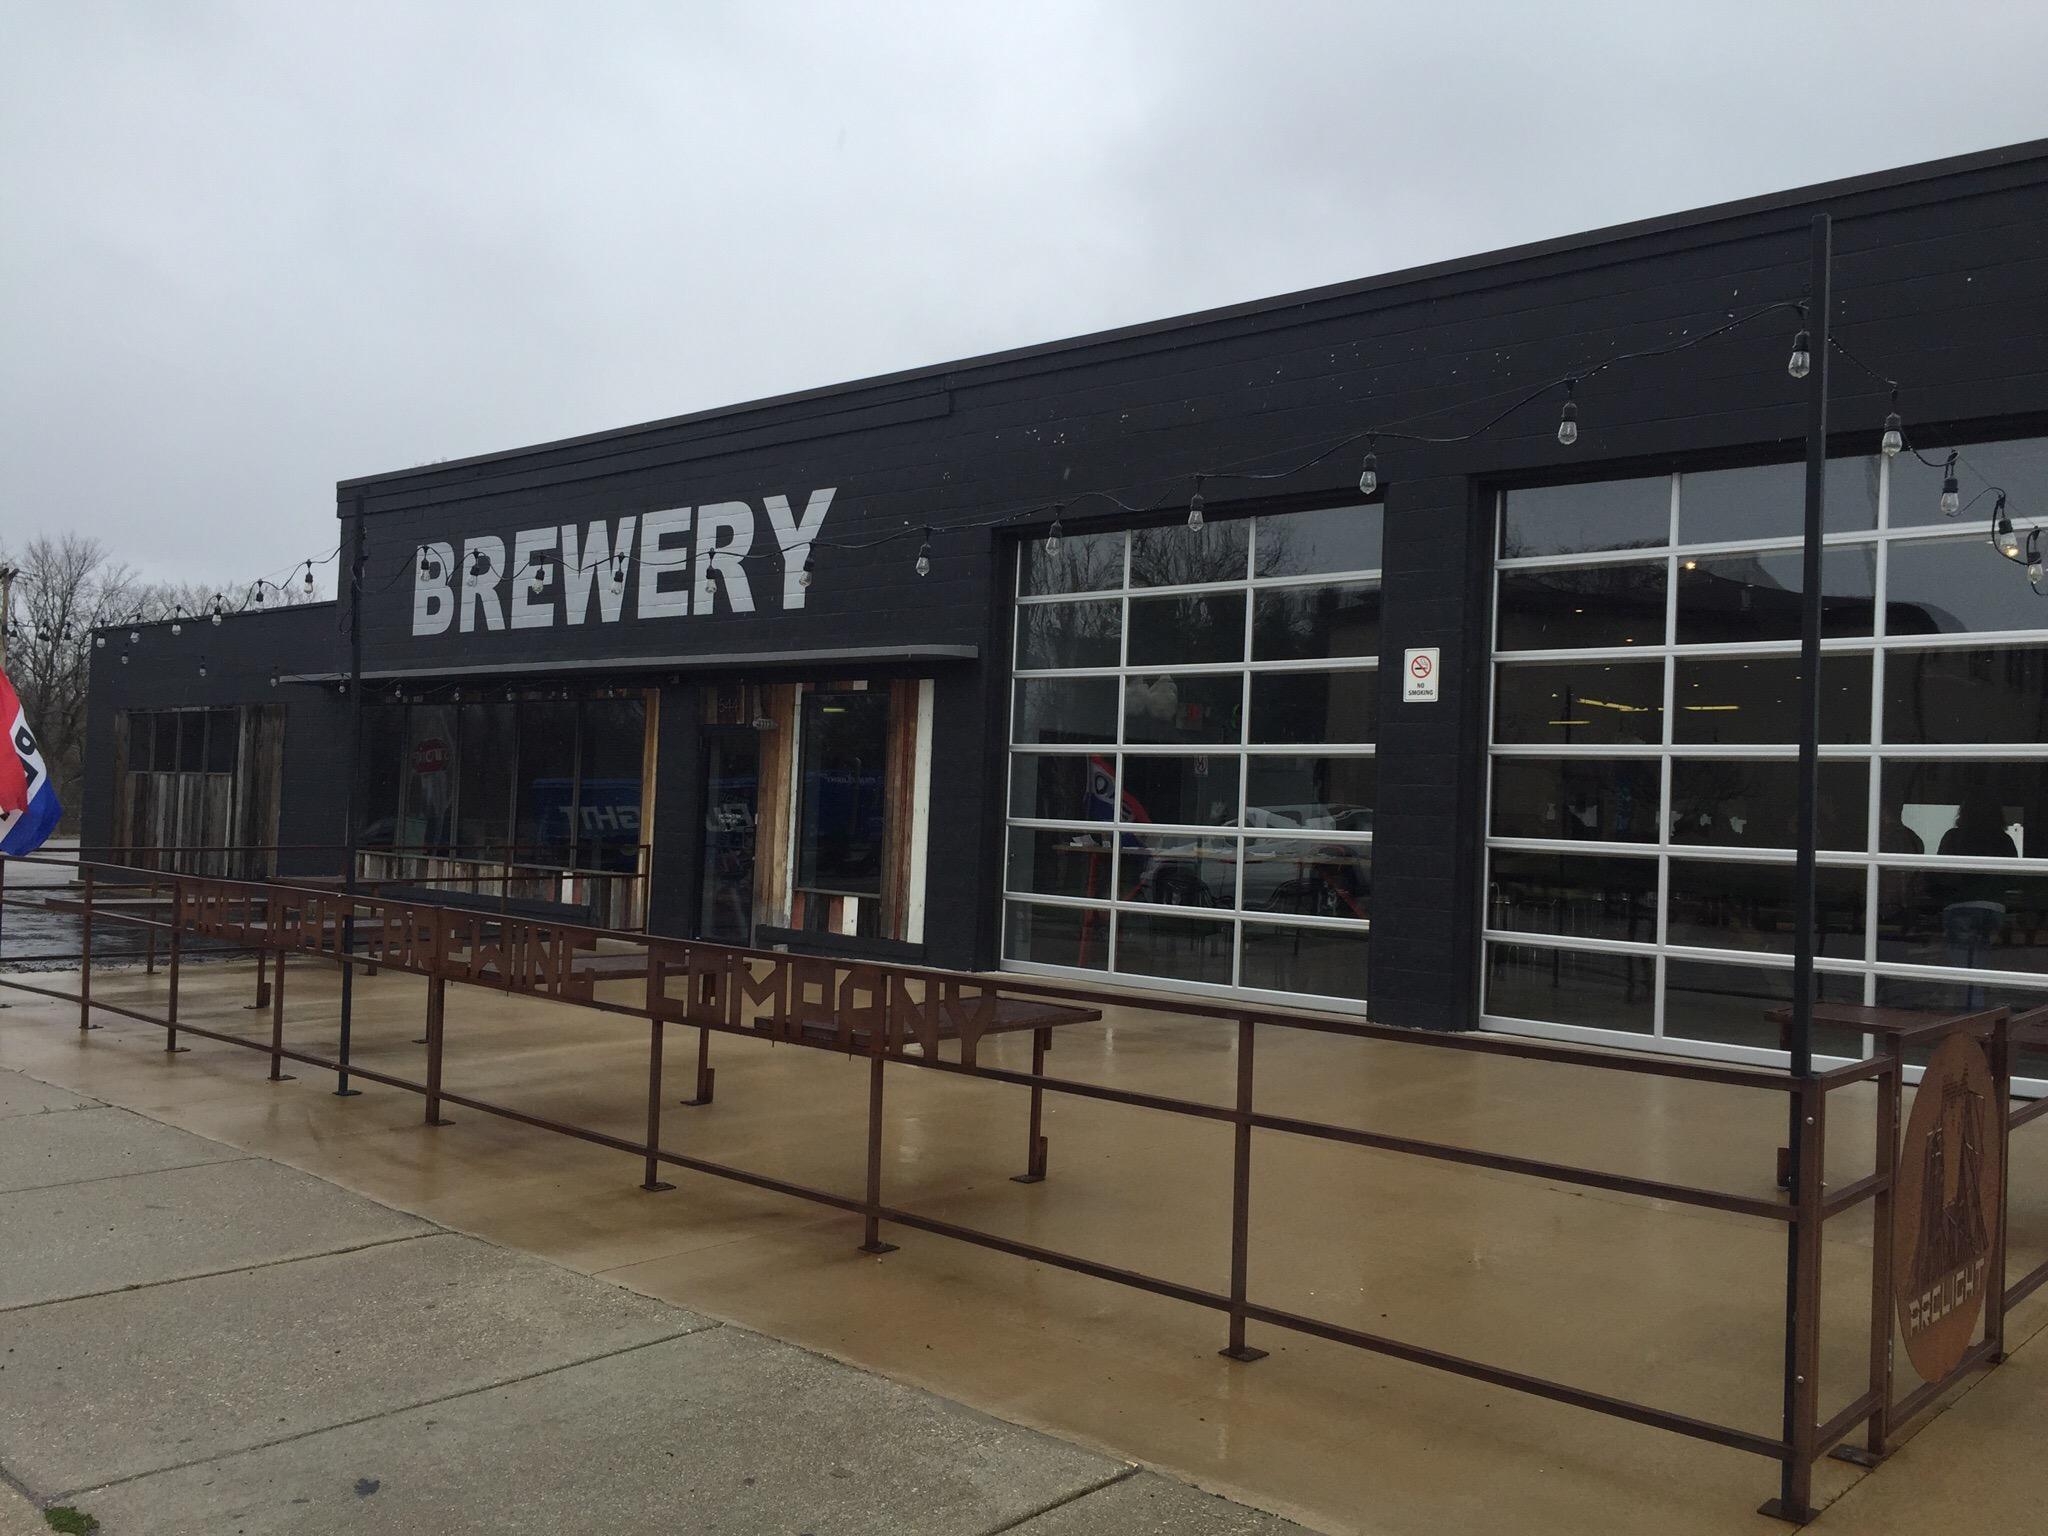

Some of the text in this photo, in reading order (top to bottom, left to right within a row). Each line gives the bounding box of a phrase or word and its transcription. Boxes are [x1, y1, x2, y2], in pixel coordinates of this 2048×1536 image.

[412, 487, 837, 636] BREWERY
[384, 902, 597, 1001] BREWING
[646, 942, 996, 1068] COMPANY
[1909, 1258, 1985, 1337] ARCLIGHT
